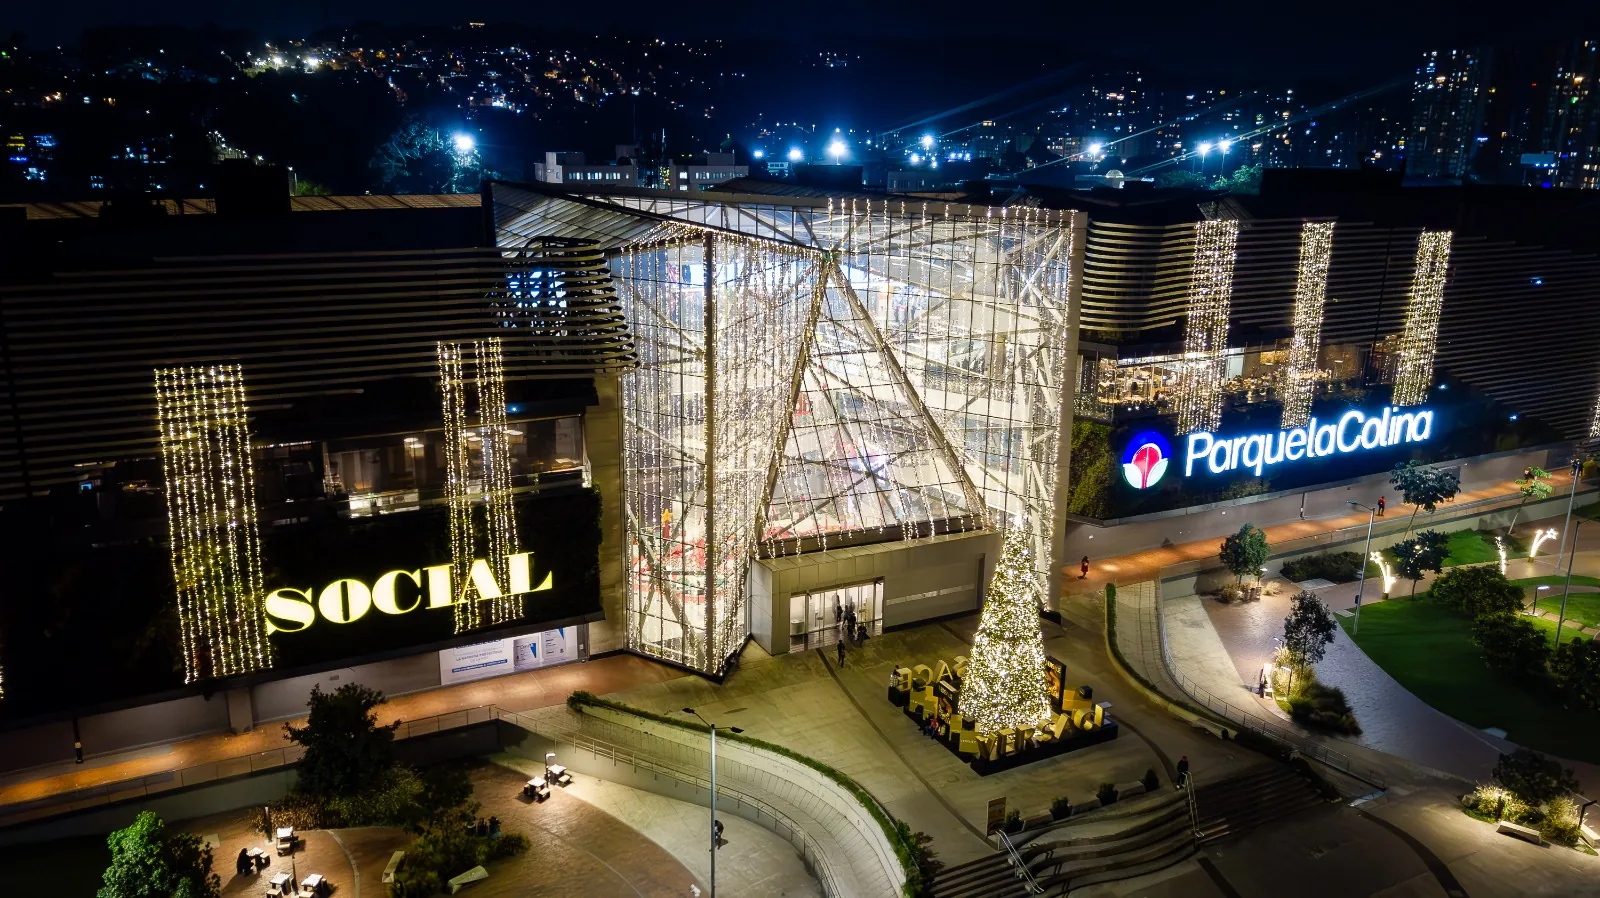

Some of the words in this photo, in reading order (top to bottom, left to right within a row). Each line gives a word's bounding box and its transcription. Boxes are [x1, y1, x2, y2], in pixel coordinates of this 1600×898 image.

[1184, 406, 1434, 478] ParquelaColina
[264, 551, 553, 636] SOCIAL
[975, 703, 1105, 761] VERSAC
